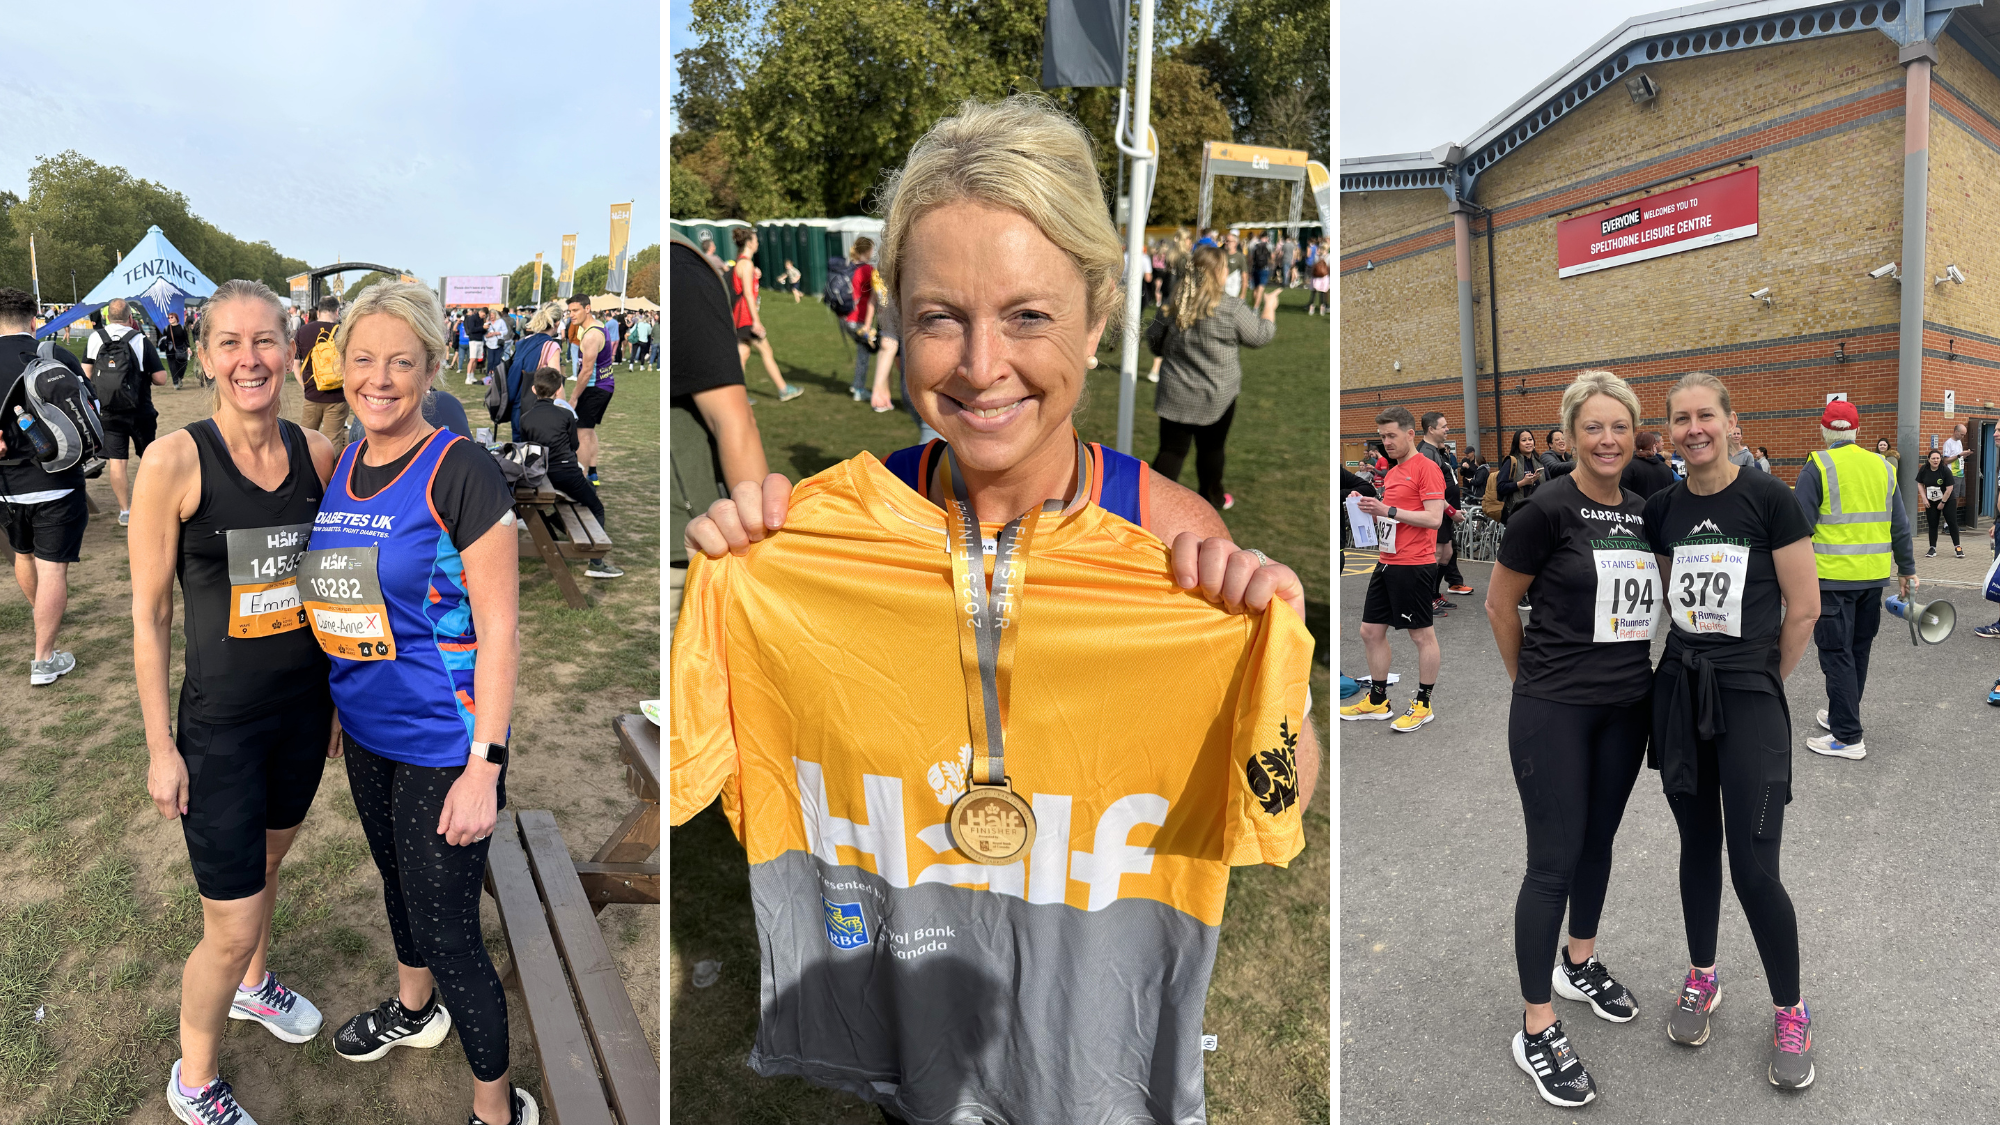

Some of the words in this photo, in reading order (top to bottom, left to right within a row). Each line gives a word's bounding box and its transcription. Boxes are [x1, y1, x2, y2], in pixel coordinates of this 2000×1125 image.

[1602, 210, 1640, 234] EVERYONE
[1643, 204, 1676, 220] WELCOMES
[1676, 200, 1689, 212] YOU
[1690, 197, 1698, 208] TO
[1590, 232, 1640, 255] SPELTHORNE
[1641, 223, 1675, 243] LEISURE
[1677, 214, 1712, 234] CENTRE
[123, 258, 197, 286] TENZING
[371, 515, 396, 530] UK
[267, 531, 298, 549] Half
[320, 555, 348, 570] Half
[1601, 560, 1636, 569] STAINES
[1645, 561, 1657, 570] 10K
[1676, 554, 1710, 565] STAINES
[1724, 554, 1743, 565] 10K
[994, 525, 1027, 630] FINISHER
[310, 578, 363, 599] 18282
[1611, 577, 1655, 615] 194
[1679, 571, 1732, 609] 379
[962, 572, 982, 629] 2023
[1619, 617, 1652, 628] Runners'
[1698, 610, 1730, 622] Runners'
[1619, 629, 1649, 639] Retreat
[1699, 621, 1729, 633] Retreat
[363, 646, 369, 655] 4
[378, 645, 387, 653] M
[966, 809, 1020, 828] Half
[792, 755, 1170, 912] Half
[970, 826, 1018, 835] FINISHER
[816, 869, 872, 894] Presented
[829, 932, 865, 946] RBC
[914, 926, 956, 942] Bank
[889, 940, 947, 960] Canada
